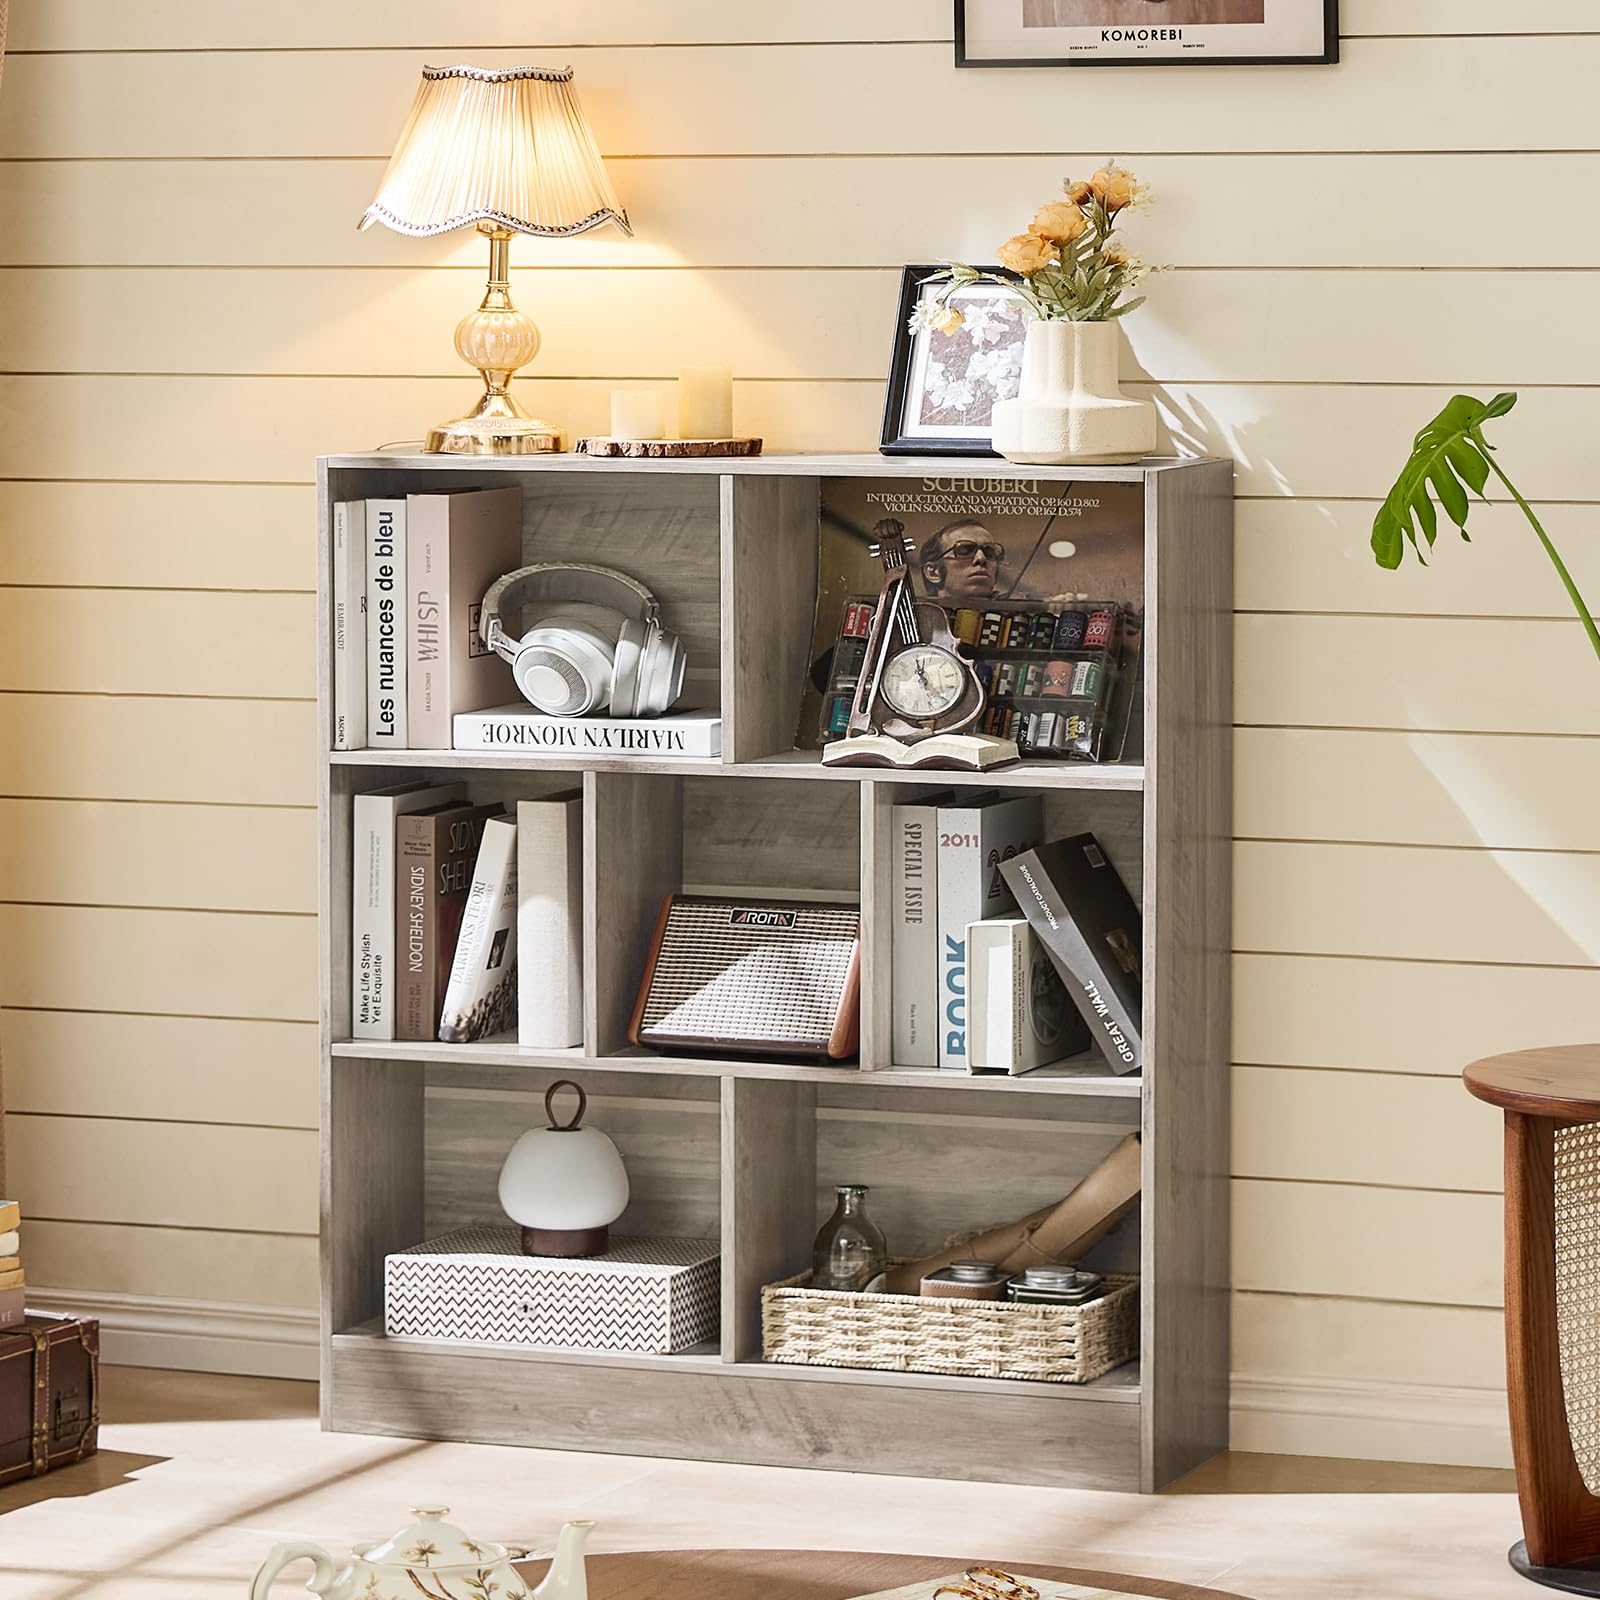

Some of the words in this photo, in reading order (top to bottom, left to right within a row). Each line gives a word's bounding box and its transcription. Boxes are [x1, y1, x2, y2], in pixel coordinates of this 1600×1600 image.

[1101, 29, 1182, 41] KOMOREBI
[866, 493, 954, 504] INTRODUCTION
[956, 494, 980, 504] AND
[980, 496, 1039, 506] VARIATION
[922, 478, 1043, 494] SCHUBERT
[884, 502, 922, 512] VIOLIN
[924, 504, 968, 514] SONATA
[374, 511, 394, 558] bleu
[374, 564, 394, 592] de
[336, 602, 344, 651] REMBRANDT
[379, 599, 394, 690] nuances
[417, 591, 439, 662] WHISP
[376, 698, 394, 737] Les
[482, 724, 577, 746] MONROE
[584, 727, 685, 750] MARILYN
[448, 819, 482, 854] SIDN
[904, 823, 922, 879] SPECIAL
[940, 833, 979, 848] 2011
[410, 866, 424, 910] SIDNEY
[1018, 864, 1043, 901] CATALOGUE
[736, 912, 788, 926] AROMA
[904, 886, 922, 924] ISSUE
[1038, 900, 1060, 930] PRODUCT
[409, 912, 424, 972] SHELDON
[452, 923, 476, 984] DARWINS
[467, 880, 486, 919] TEORI
[360, 934, 372, 970] Stylish
[360, 972, 370, 992] Life
[372, 954, 382, 1004] Exquisite
[946, 934, 966, 1056] BOOK
[360, 994, 370, 1024] Make
[372, 1006, 381, 1024] Yet
[1084, 979, 1110, 1018] WALL
[1104, 1021, 1135, 1063] GREAT
